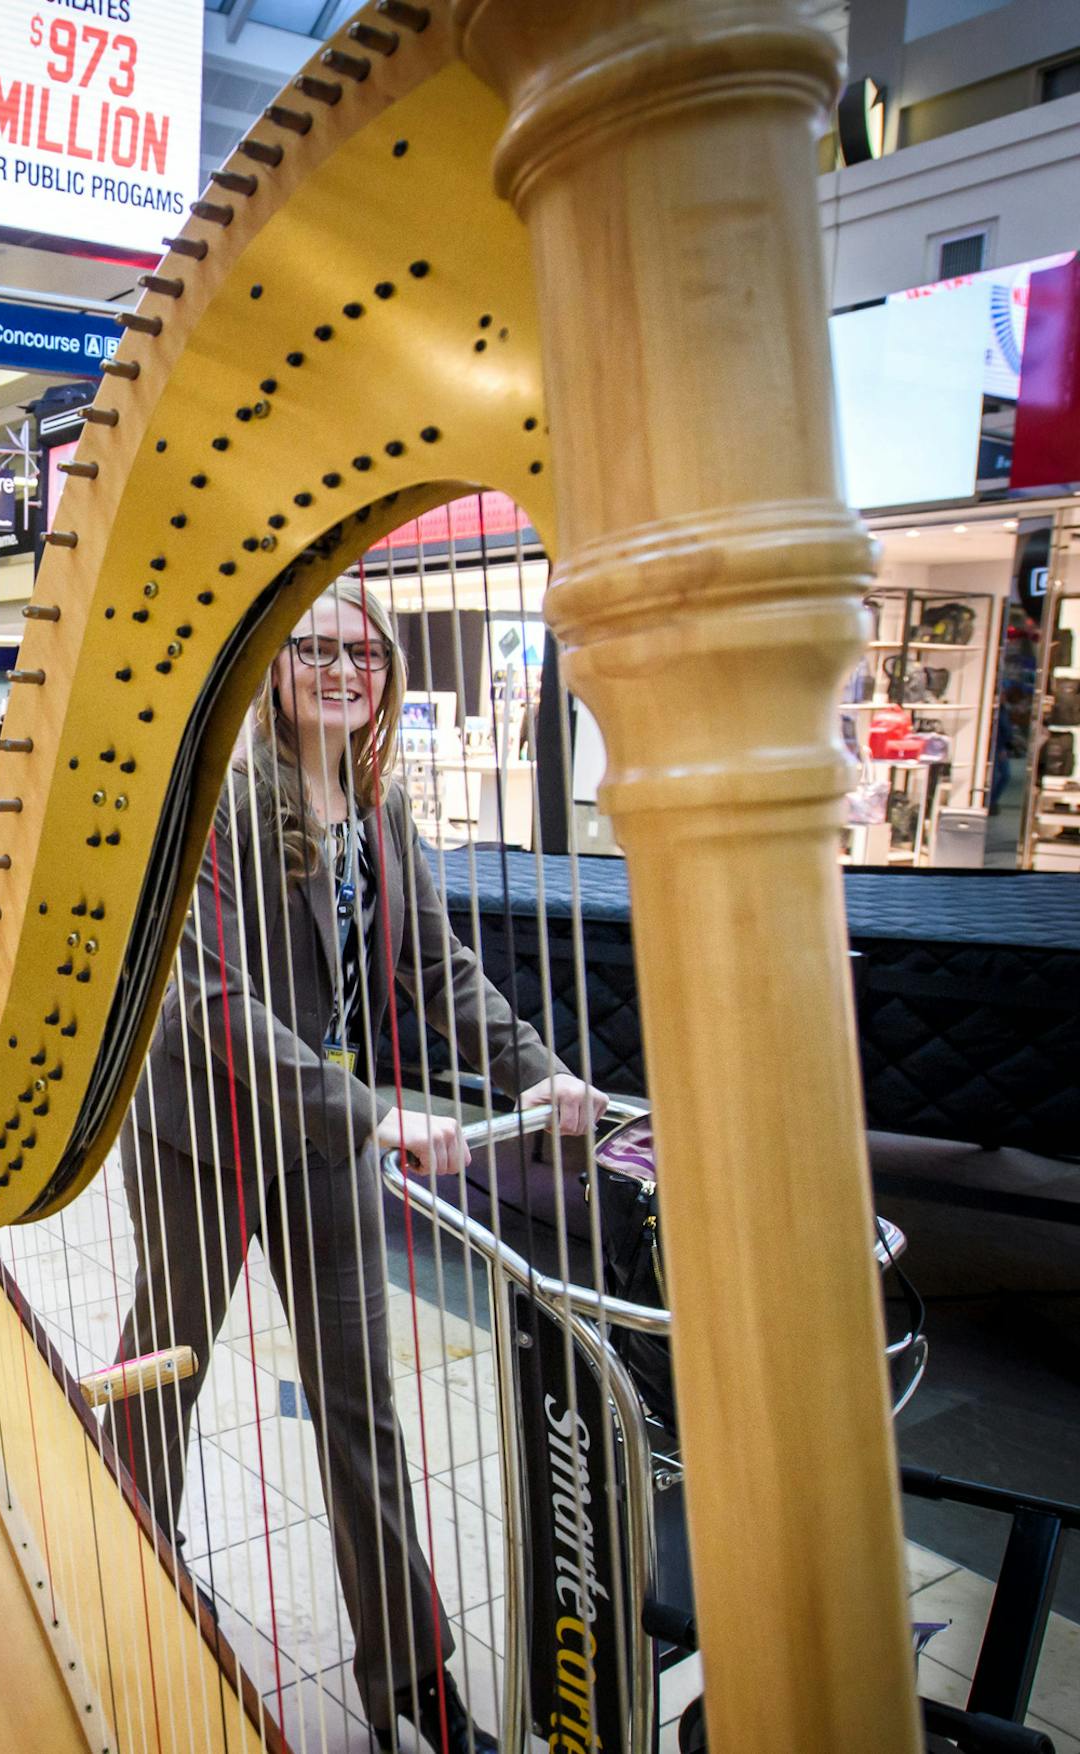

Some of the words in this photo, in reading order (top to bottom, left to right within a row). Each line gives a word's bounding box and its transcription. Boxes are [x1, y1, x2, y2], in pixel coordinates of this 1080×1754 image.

[29, 13, 138, 97] $973
[15, 159, 85, 195] PUBLIC
[91, 175, 184, 215] PROGAMS
[86, 335, 101, 356] A
